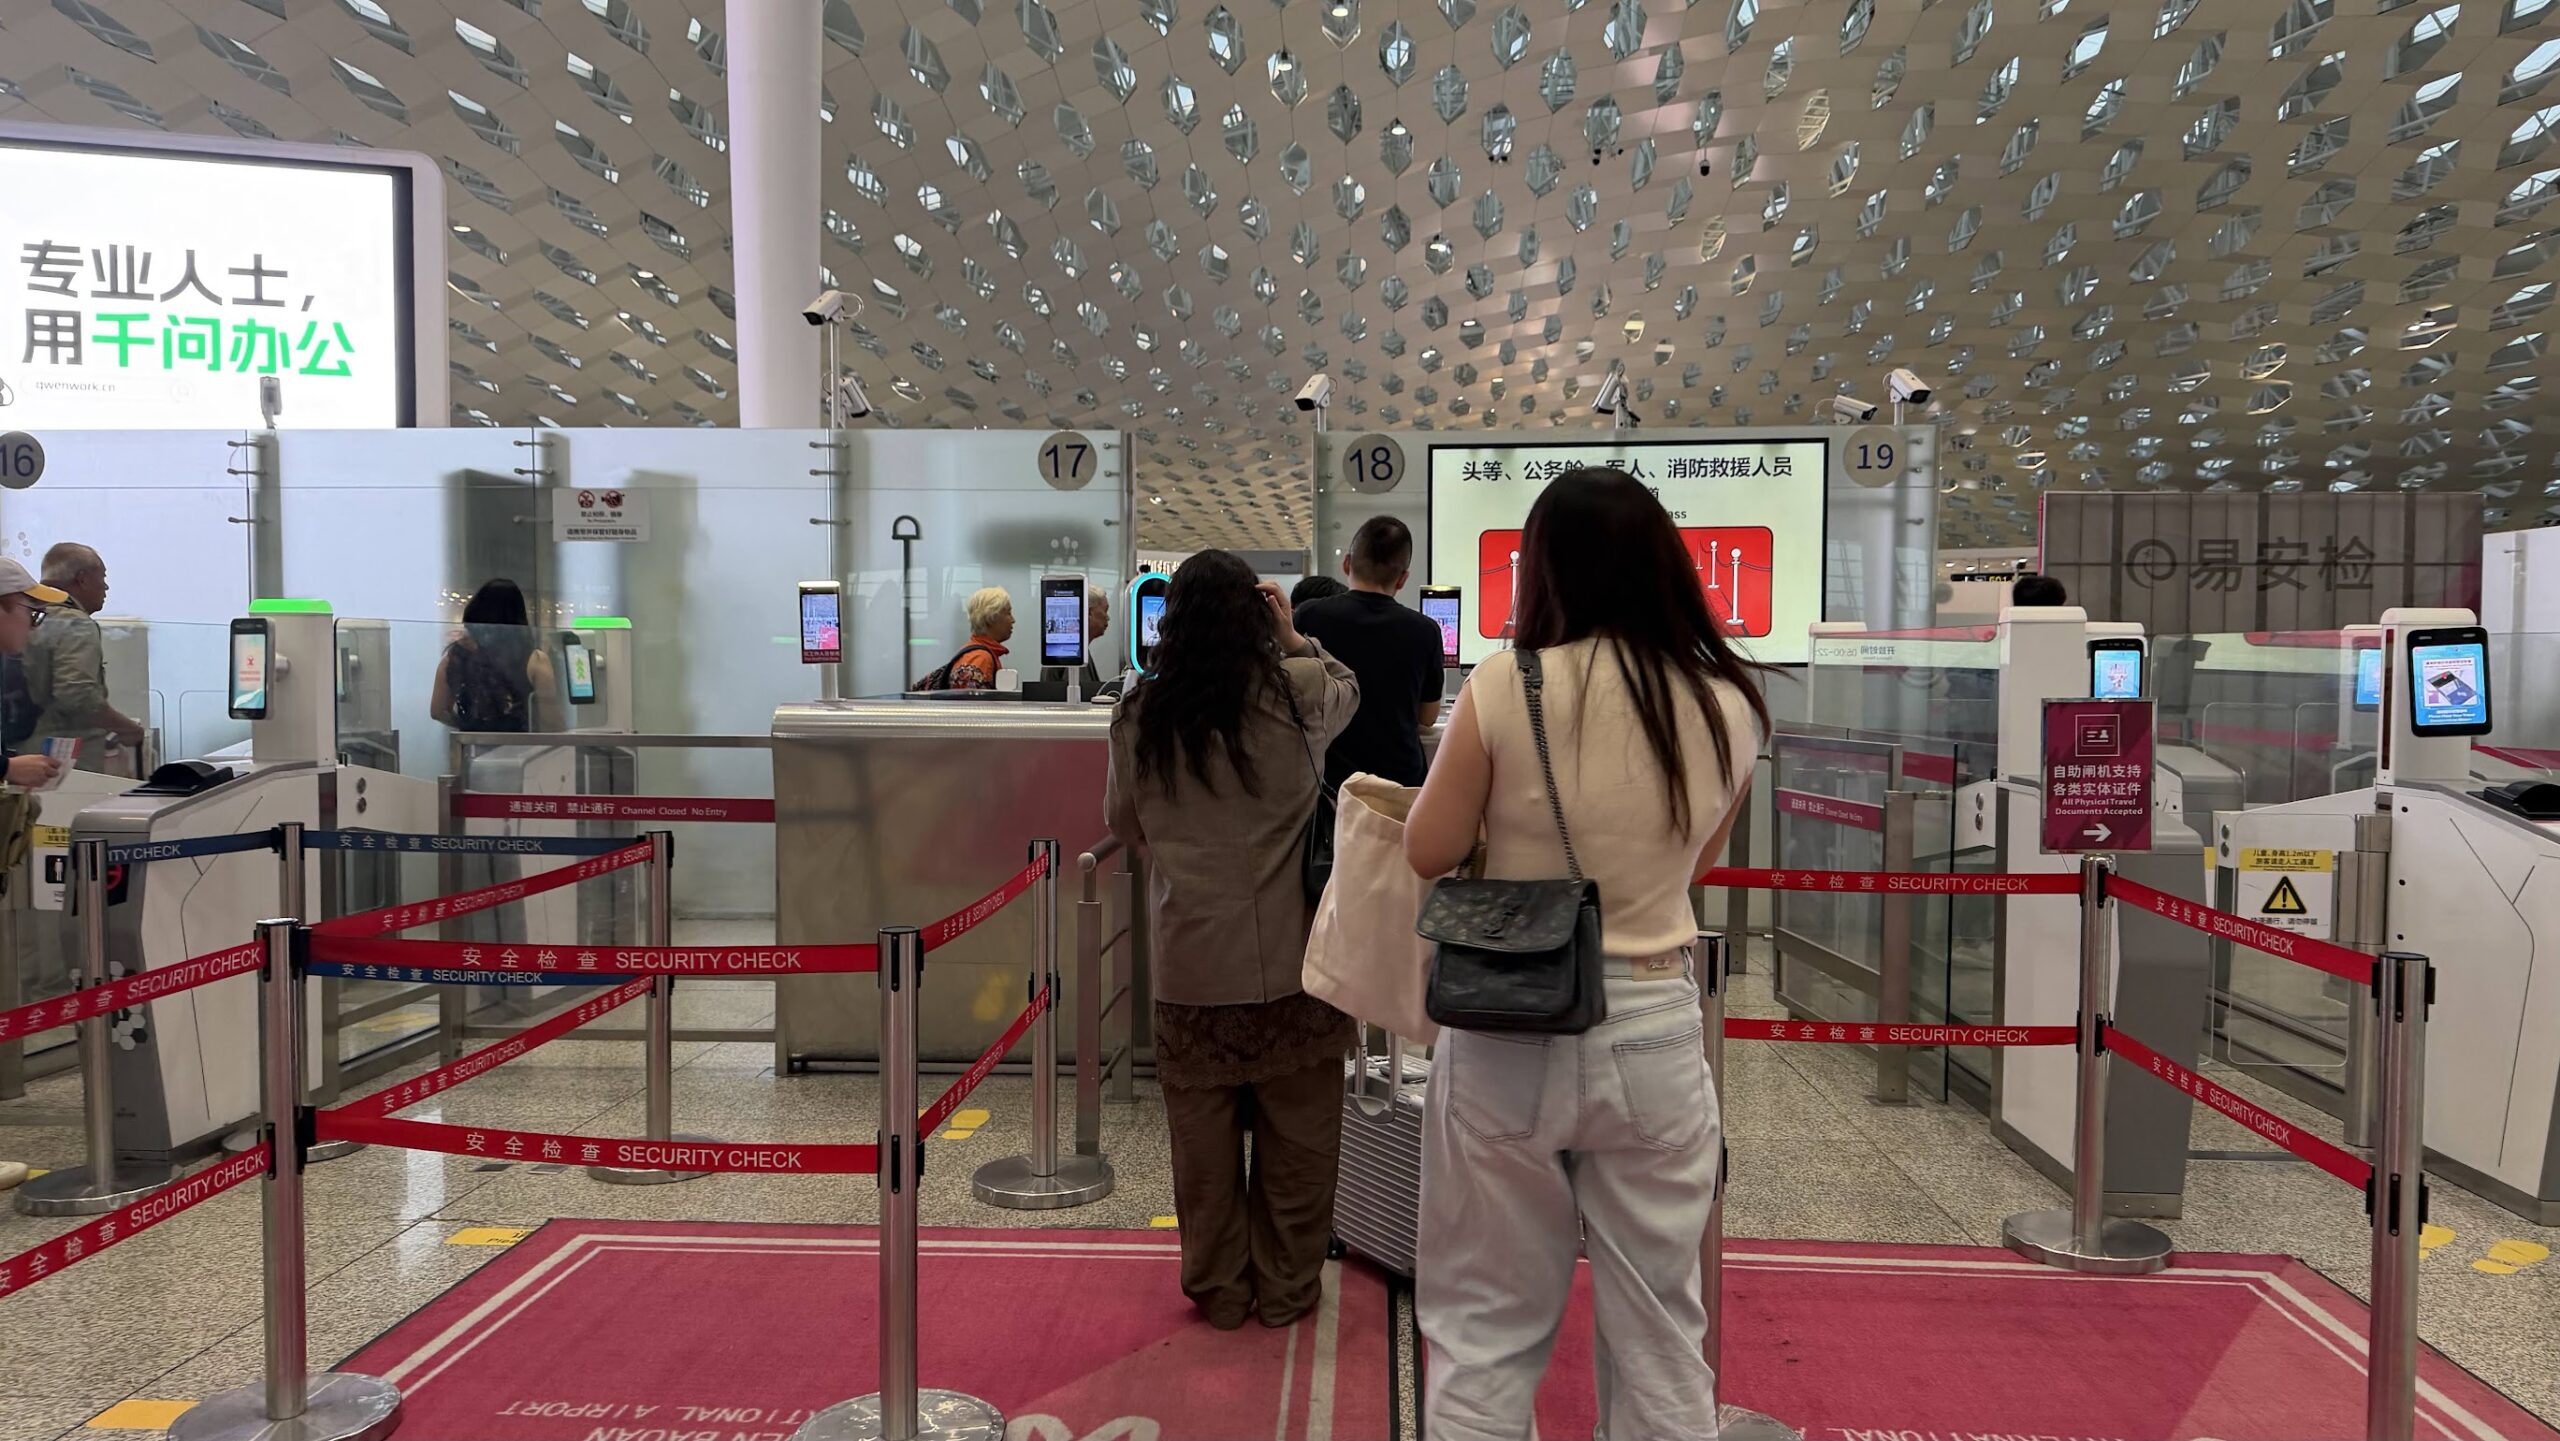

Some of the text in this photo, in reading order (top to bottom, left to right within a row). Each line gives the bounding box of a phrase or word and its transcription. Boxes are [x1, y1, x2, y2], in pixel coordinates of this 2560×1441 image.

[22, 308, 355, 376] 用千问办公
[35, 381, 116, 391] qwenwork.cn
[0, 443, 35, 477] 16
[1045, 444, 1088, 478] 17
[1349, 446, 1393, 483] 18
[1856, 443, 1895, 470] 19
[2190, 535, 2375, 592] 易安检
[2053, 764, 2141, 778] 自助闸机支持
[2053, 782, 2141, 796] 各类实体证件
[509, 801, 727, 818] 通道关闭 禁止通行 Channel Closed No Entry
[2075, 798, 2109, 808] Physical
[2104, 808, 2143, 816] Accepted
[133, 844, 181, 860] CHECK
[339, 834, 543, 851] 安全检查 SECURITY CHECK
[1770, 871, 2029, 891] 安全检查 SECURITY CHECK
[2156, 896, 2294, 956] 安全检查 SECURITY CHECK
[462, 947, 801, 971] 安全检查 SECURITY CHECK
[127, 962, 209, 1000] SECURITY
[210, 947, 260, 976] CHECK
[341, 963, 543, 984] 安全检查 SECURITY CHECK
[1770, 1023, 2029, 1043] 安全检查 SECURITY CHECK
[2153, 1056, 2290, 1145] 安全检查 SECURITY CHECK
[466, 1131, 801, 1168] 安全检查 SECURITY CHECK
[130, 1176, 211, 1229] SECURITY
[214, 1153, 265, 1188] CHECK
[497, 1400, 663, 1419] AIRPORT
